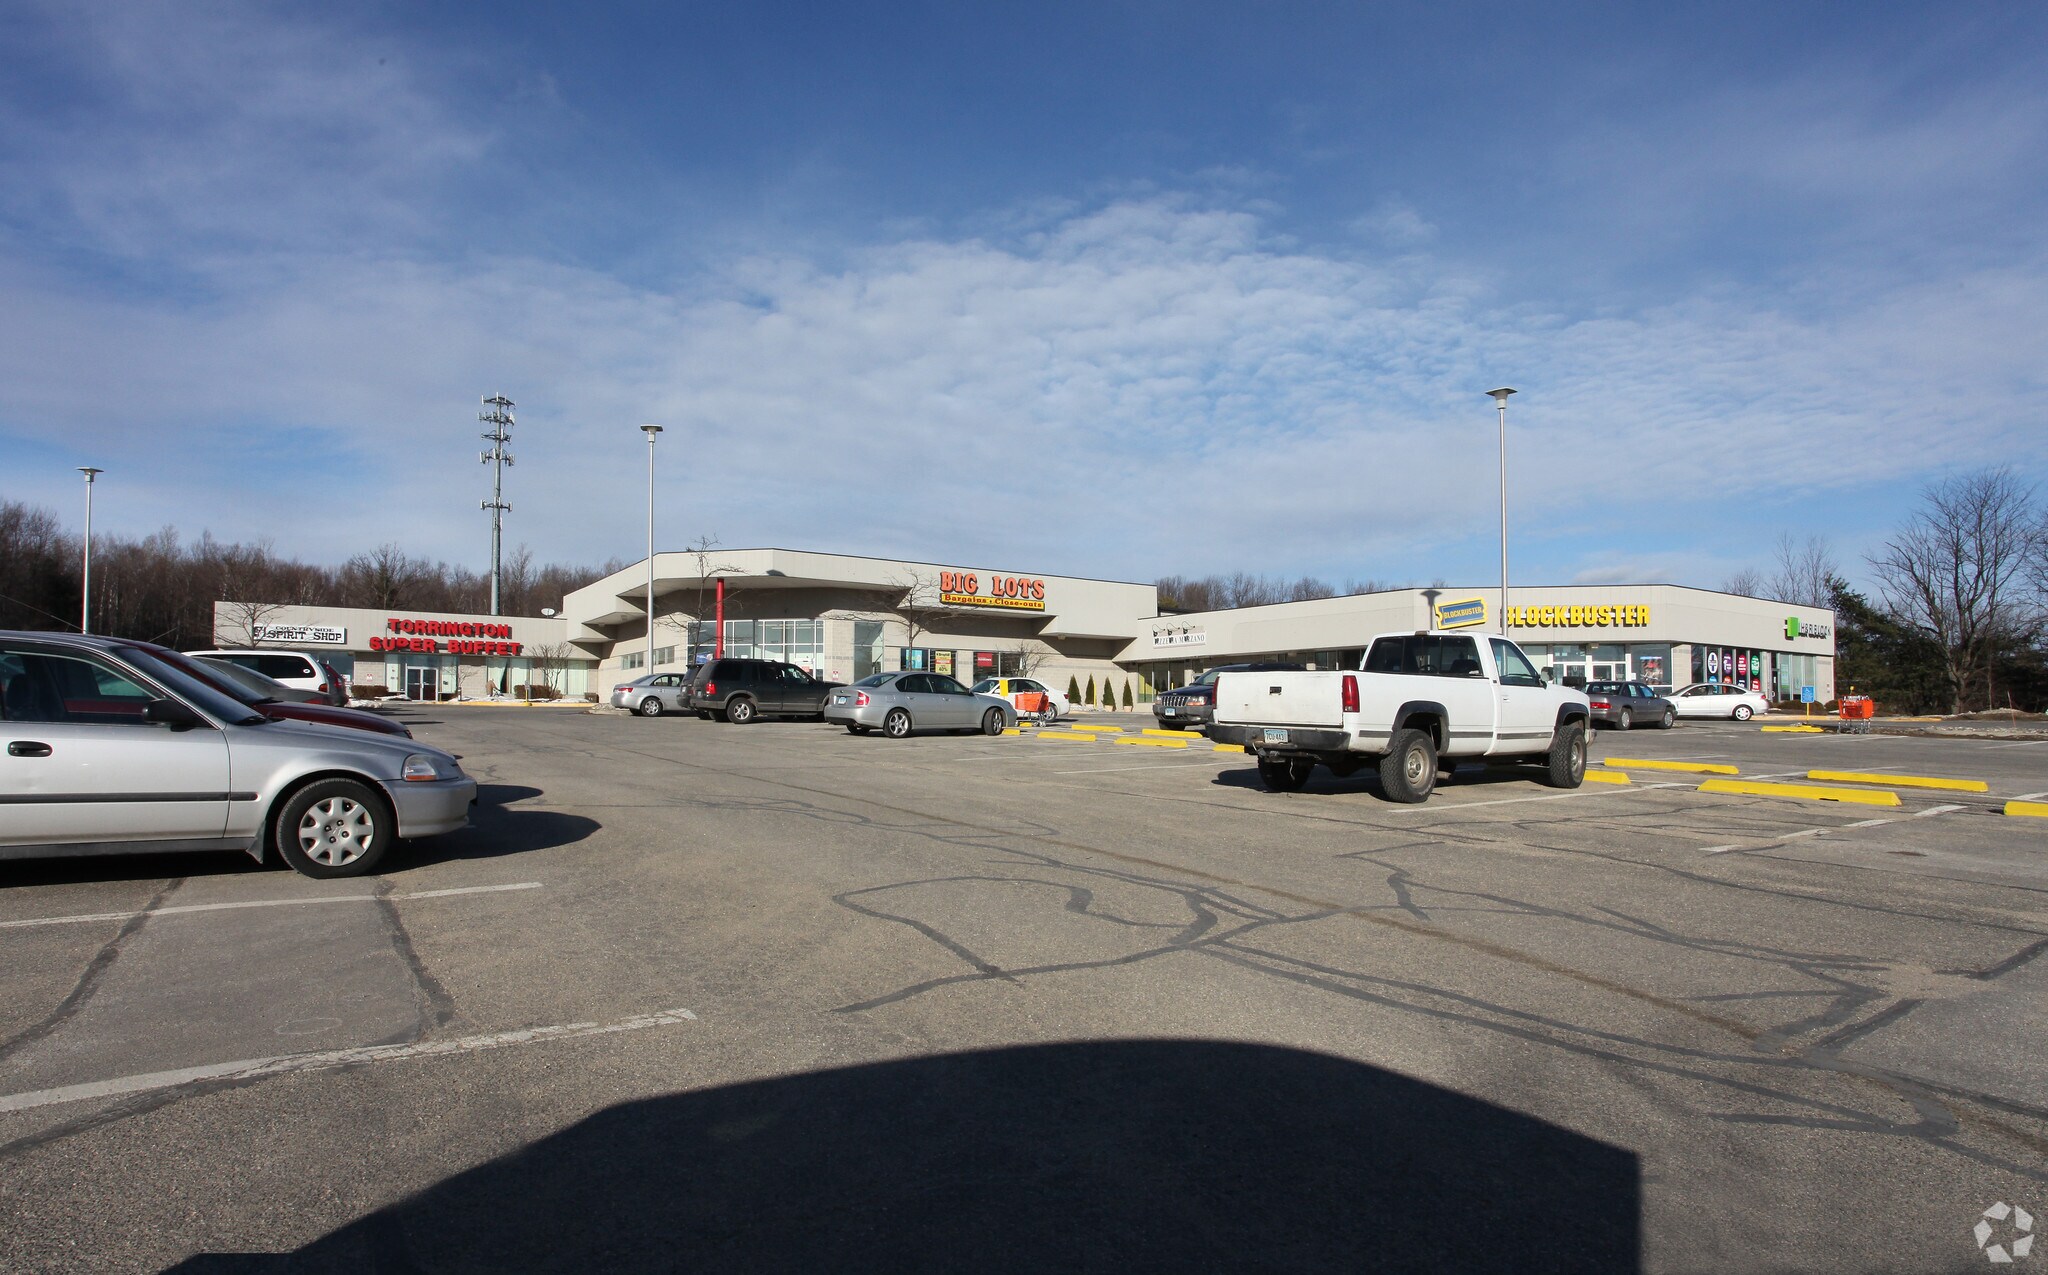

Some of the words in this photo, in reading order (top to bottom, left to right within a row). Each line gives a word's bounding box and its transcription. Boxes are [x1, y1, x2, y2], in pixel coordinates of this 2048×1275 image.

[940, 571, 978, 594] BIG
[992, 575, 1045, 599] LOTS
[945, 594, 987, 604] Bargains
[1443, 606, 1482, 619] BLOCKBUSTER
[1505, 605, 1651, 626] BLOCKBUSTER
[267, 630, 306, 639] SPIRIT
[313, 632, 342, 641] SHOP
[275, 625, 335, 633] COUNTRYSIDE
[388, 618, 510, 638] TORRINGTON
[369, 637, 436, 653] SUPER
[447, 639, 521, 655] BUFFET
